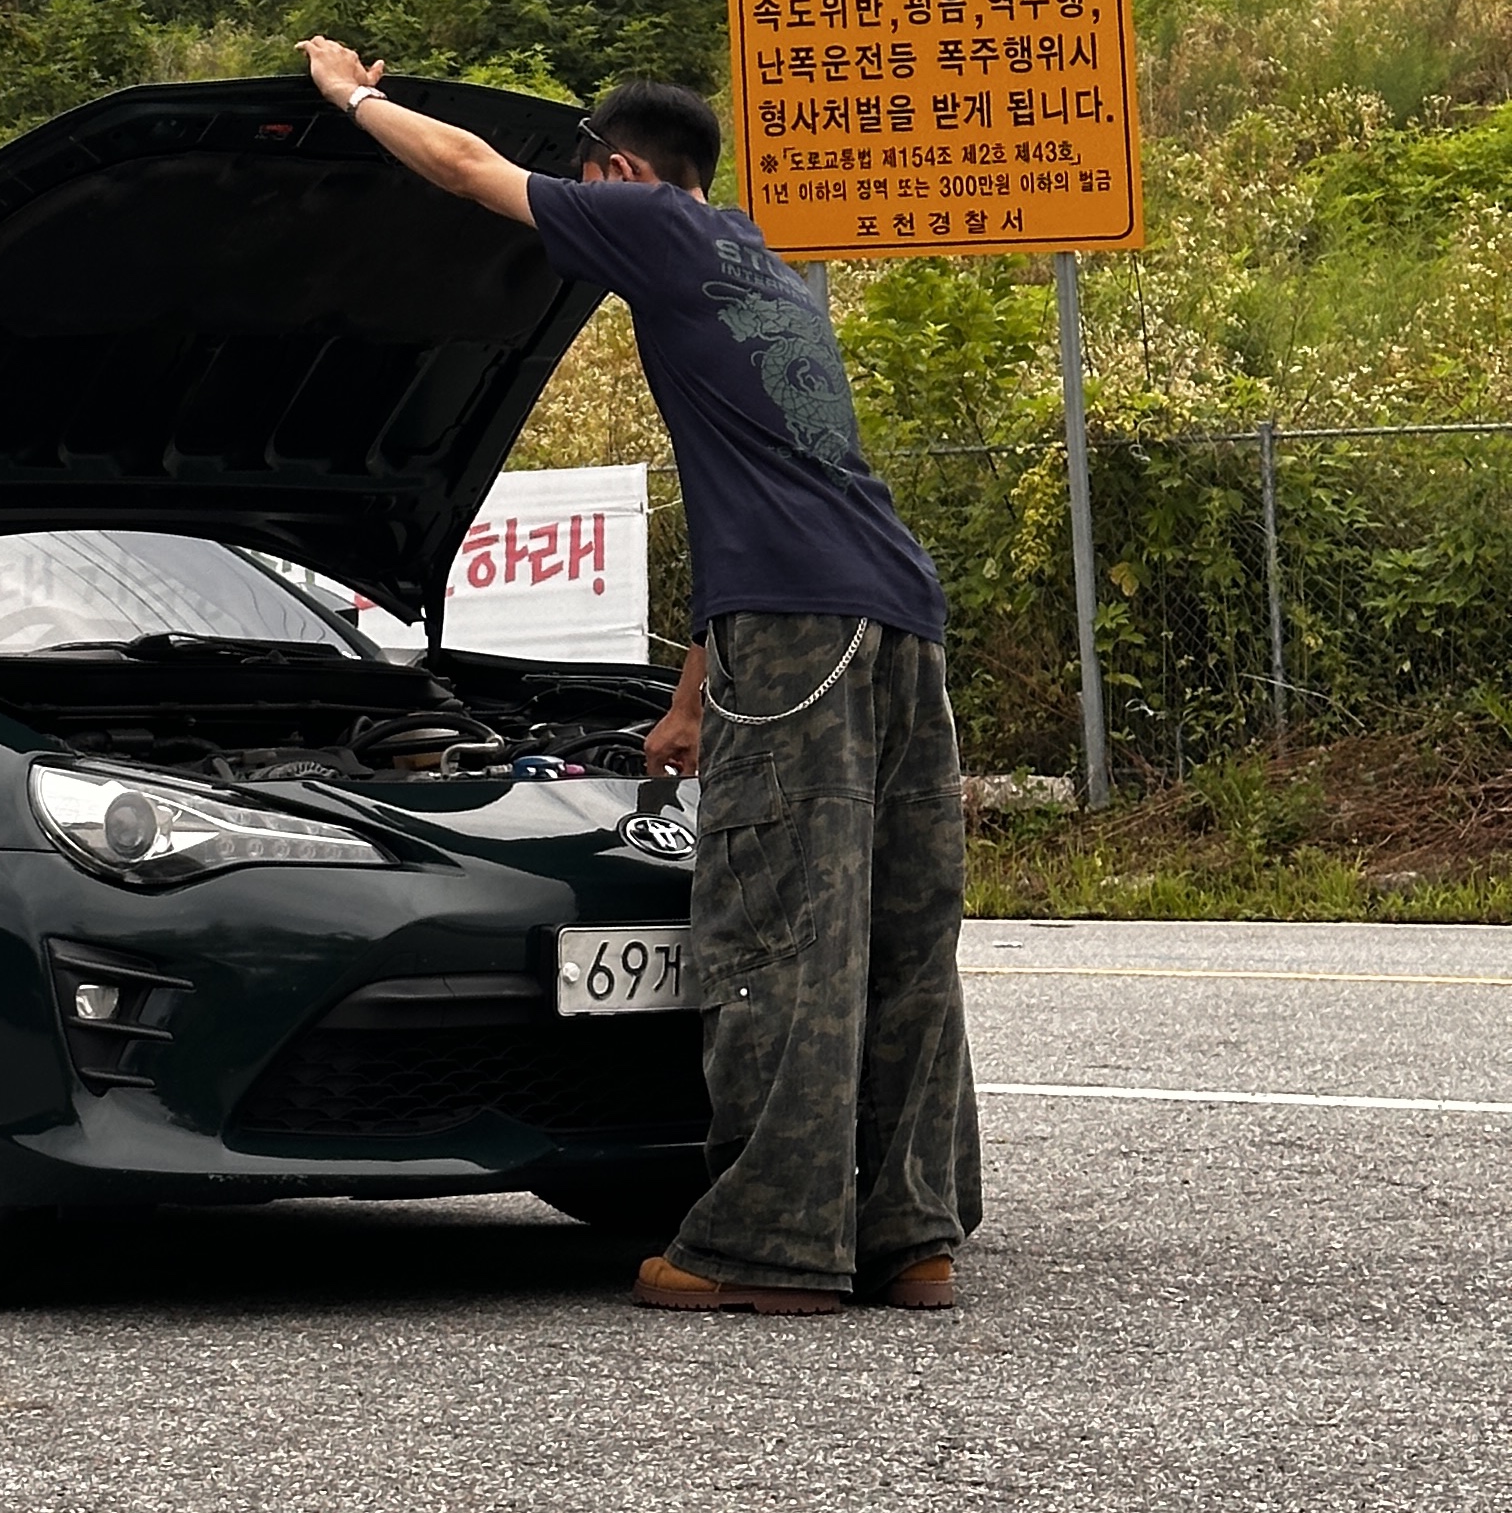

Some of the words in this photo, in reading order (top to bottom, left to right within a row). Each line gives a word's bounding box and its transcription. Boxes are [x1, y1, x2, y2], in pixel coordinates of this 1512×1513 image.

[757, 42, 917, 85] 난폭운전등
[937, 32, 1098, 77] 폭주행위시
[758, 94, 916, 137] 형사처벌을
[932, 90, 992, 129] 받게
[1007, 85, 1114, 127] 됩니다.
[882, 144, 953, 169] 제154조
[762, 182, 789, 204] 1년
[799, 179, 847, 202] 이하의
[857, 178, 888, 201] 징역
[897, 177, 930, 199] 또는
[939, 172, 1011, 198] 300만원
[1020, 170, 1069, 194] 이하의
[1079, 169, 1111, 192] 벌금
